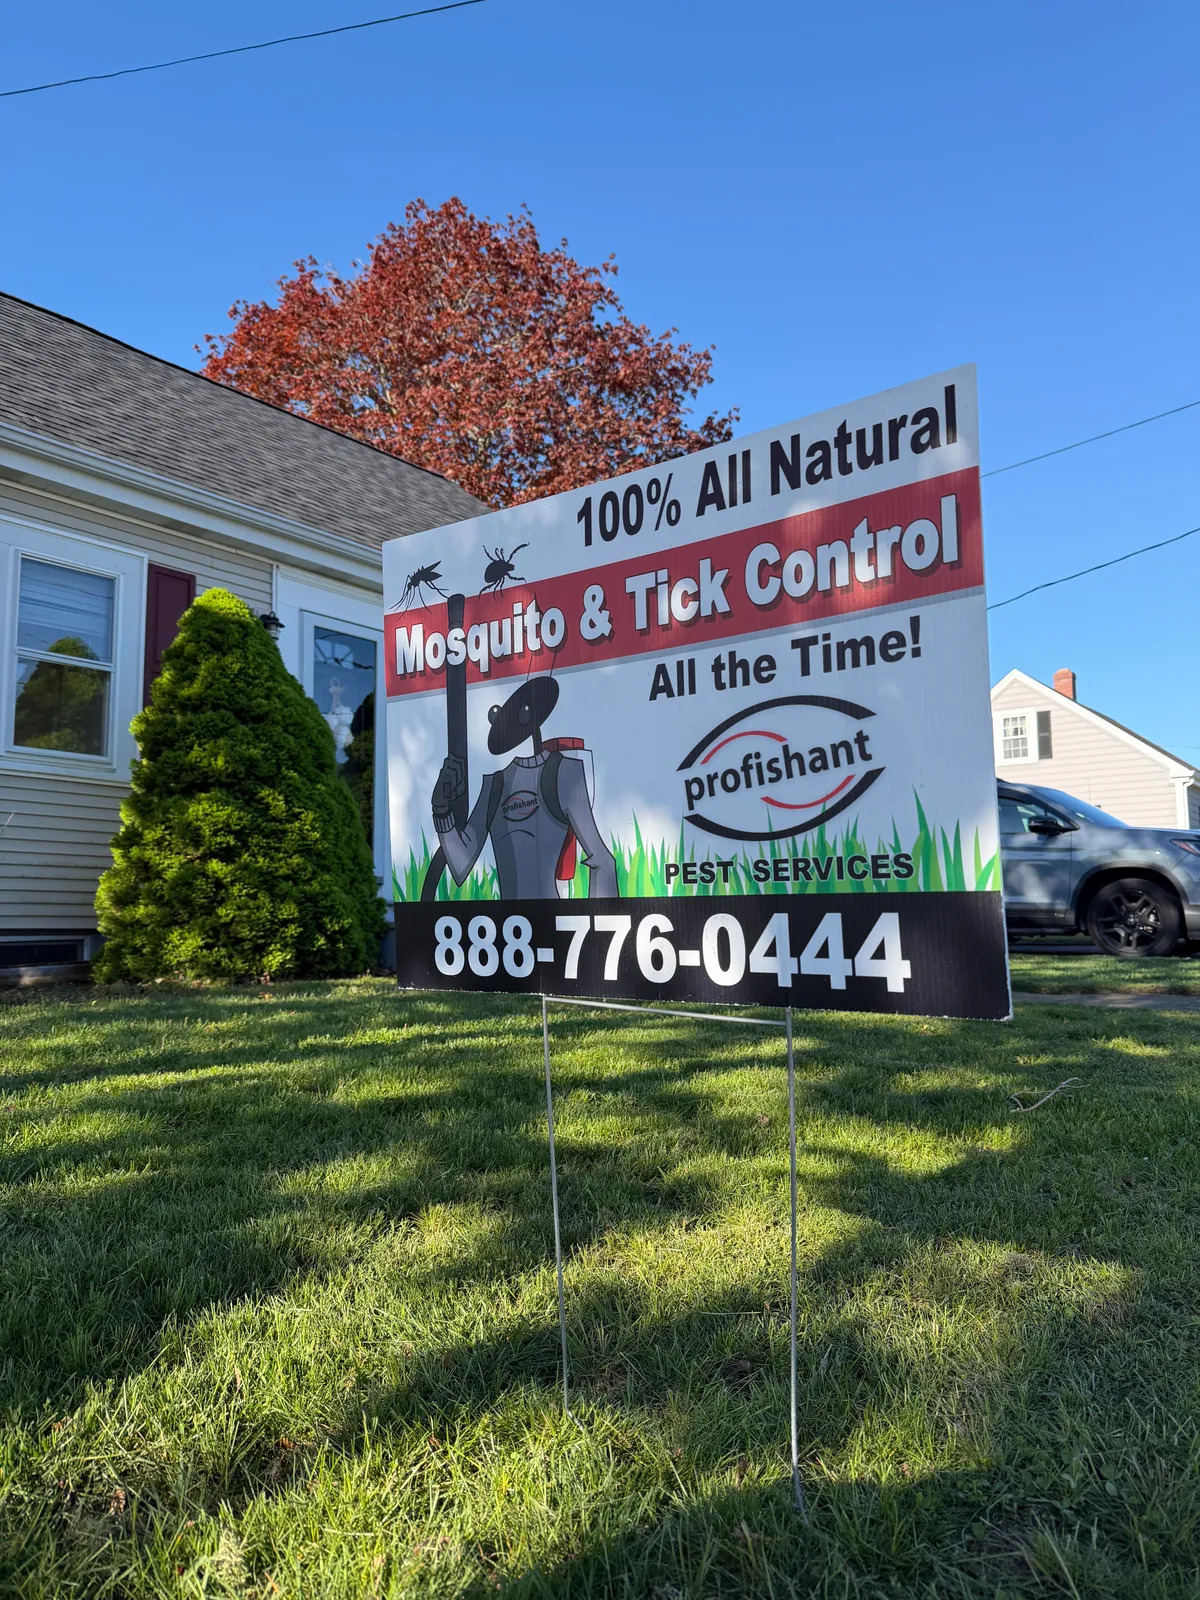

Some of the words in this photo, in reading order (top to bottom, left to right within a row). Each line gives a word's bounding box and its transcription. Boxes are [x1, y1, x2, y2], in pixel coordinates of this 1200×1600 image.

[577, 473, 681, 548] 100%
[696, 449, 751, 517] All
[770, 384, 958, 496] Natural
[394, 600, 566, 677] Mosquito
[579, 584, 612, 641] &
[625, 563, 732, 631] Tick
[745, 495, 961, 606] Control
[649, 658, 696, 700] All
[711, 650, 777, 692] the
[791, 615, 922, 676] Time!
[502, 797, 538, 815] profishant
[683, 729, 873, 810] profishant
[665, 860, 735, 885] PEST
[753, 853, 915, 882] SERVICES
[434, 911, 912, 993] 888-776-0444
